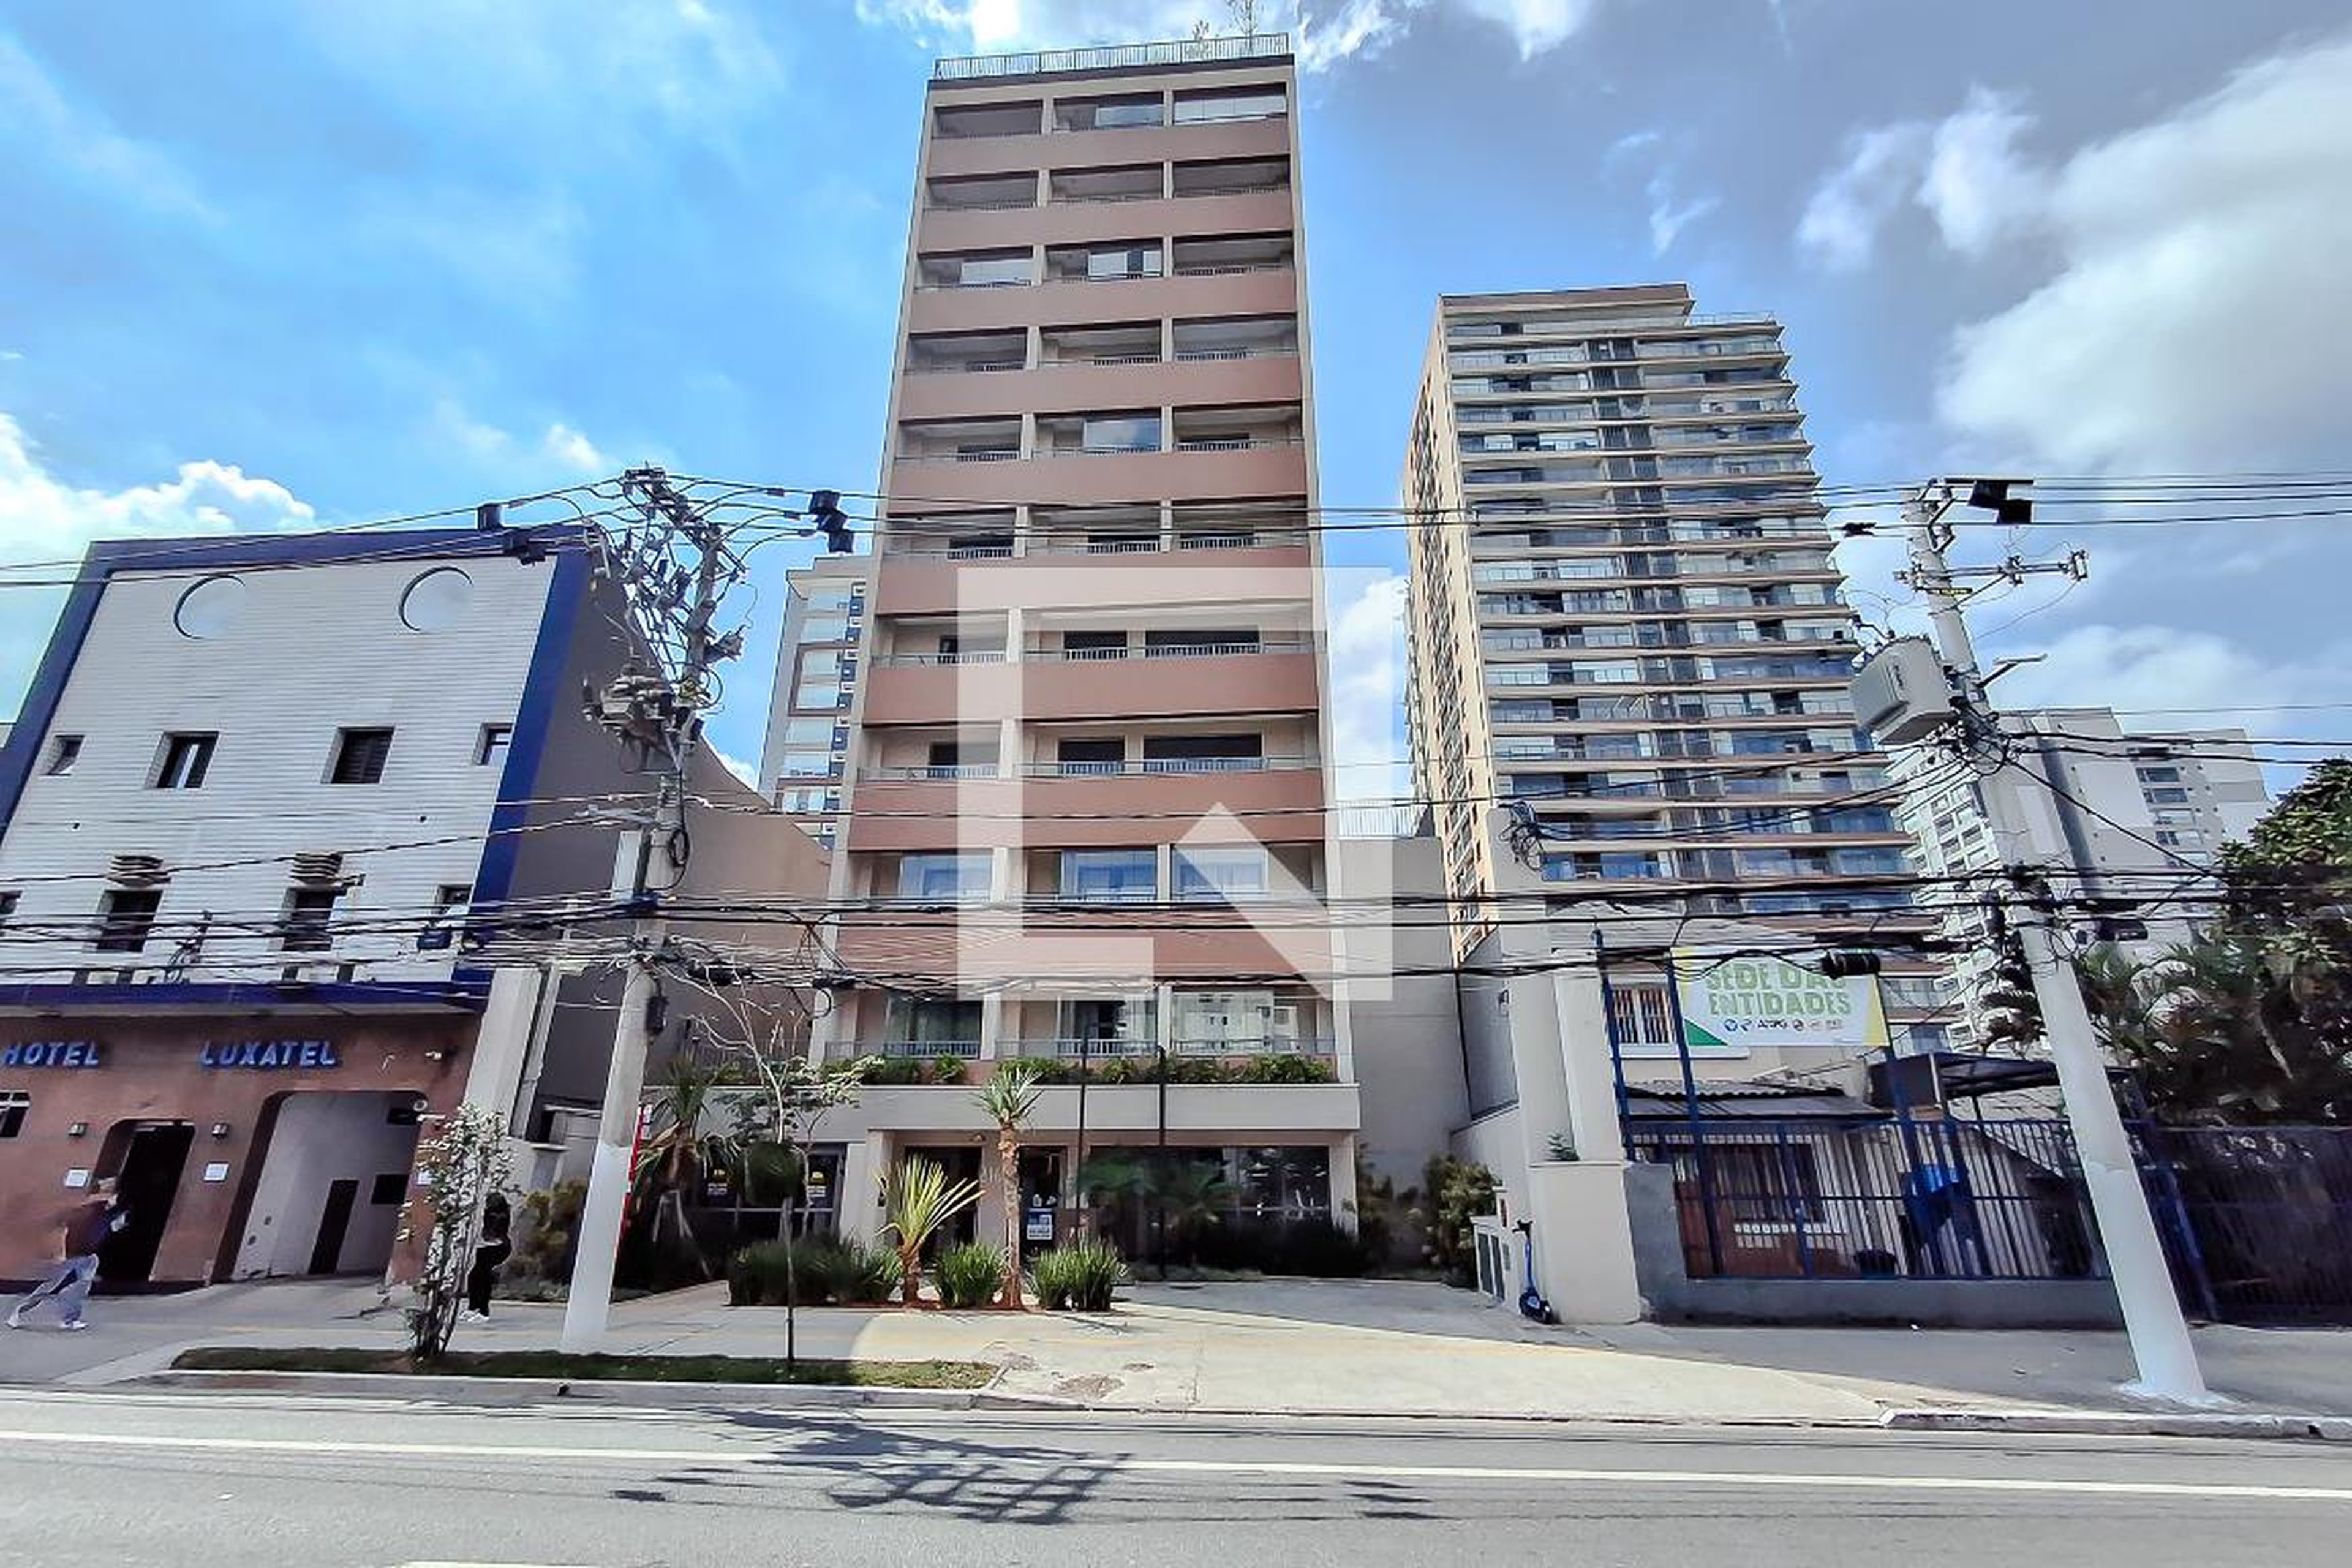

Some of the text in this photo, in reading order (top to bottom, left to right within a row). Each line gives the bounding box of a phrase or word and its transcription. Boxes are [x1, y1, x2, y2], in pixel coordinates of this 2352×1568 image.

[1706, 963, 1771, 990] SEDE
[1709, 992, 1851, 1016] ENTIDADES
[0, 1041, 336, 1066] HOTEL LUXATEL
